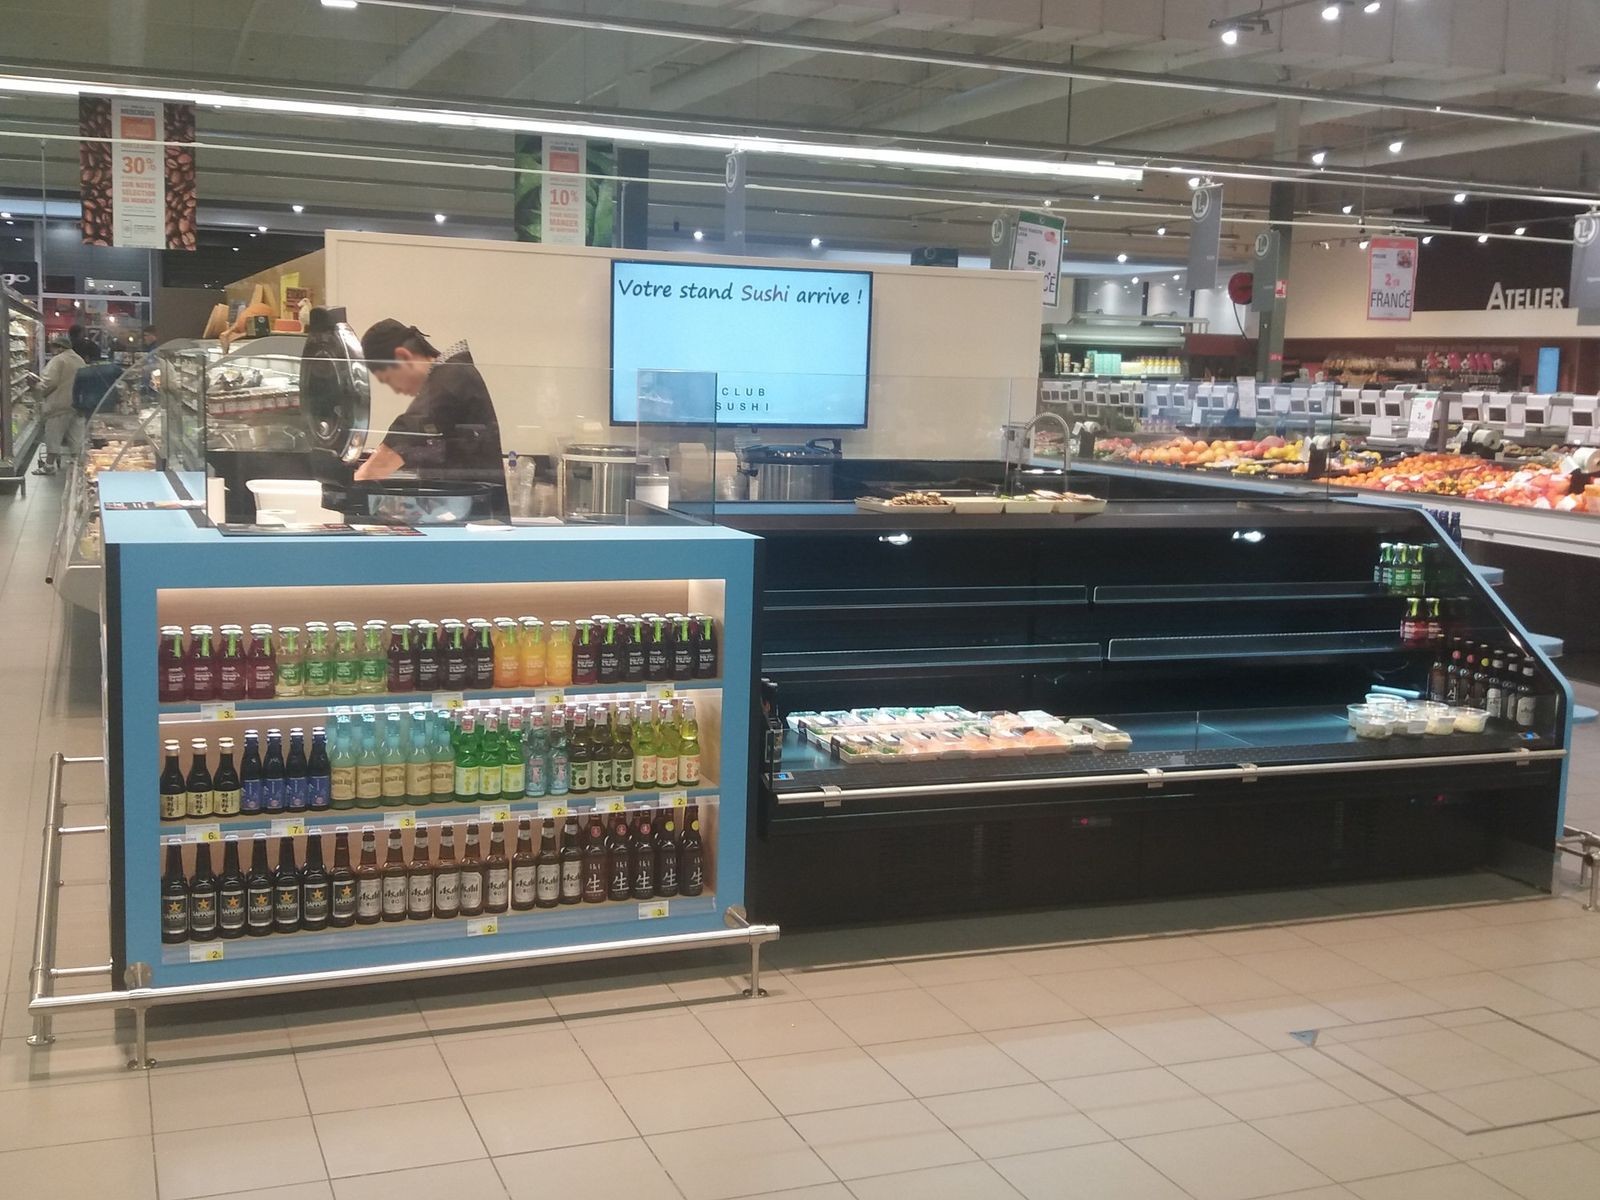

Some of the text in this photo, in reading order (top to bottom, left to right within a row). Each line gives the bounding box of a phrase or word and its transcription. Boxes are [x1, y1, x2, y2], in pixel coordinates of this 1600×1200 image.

[122, 156, 156, 174] 30%
[550, 188, 579, 206] 10%
[618, 280, 862, 304] Votre stand Sushi arrive !
[1486, 282, 1564, 310] ATELIER
[722, 387, 766, 397] CLUB
[714, 402, 770, 412] SUSHI
[585, 874, 604, 893] 生
[612, 872, 630, 891] 生
[635, 870, 653, 889] 生
[661, 868, 678, 887] 生
